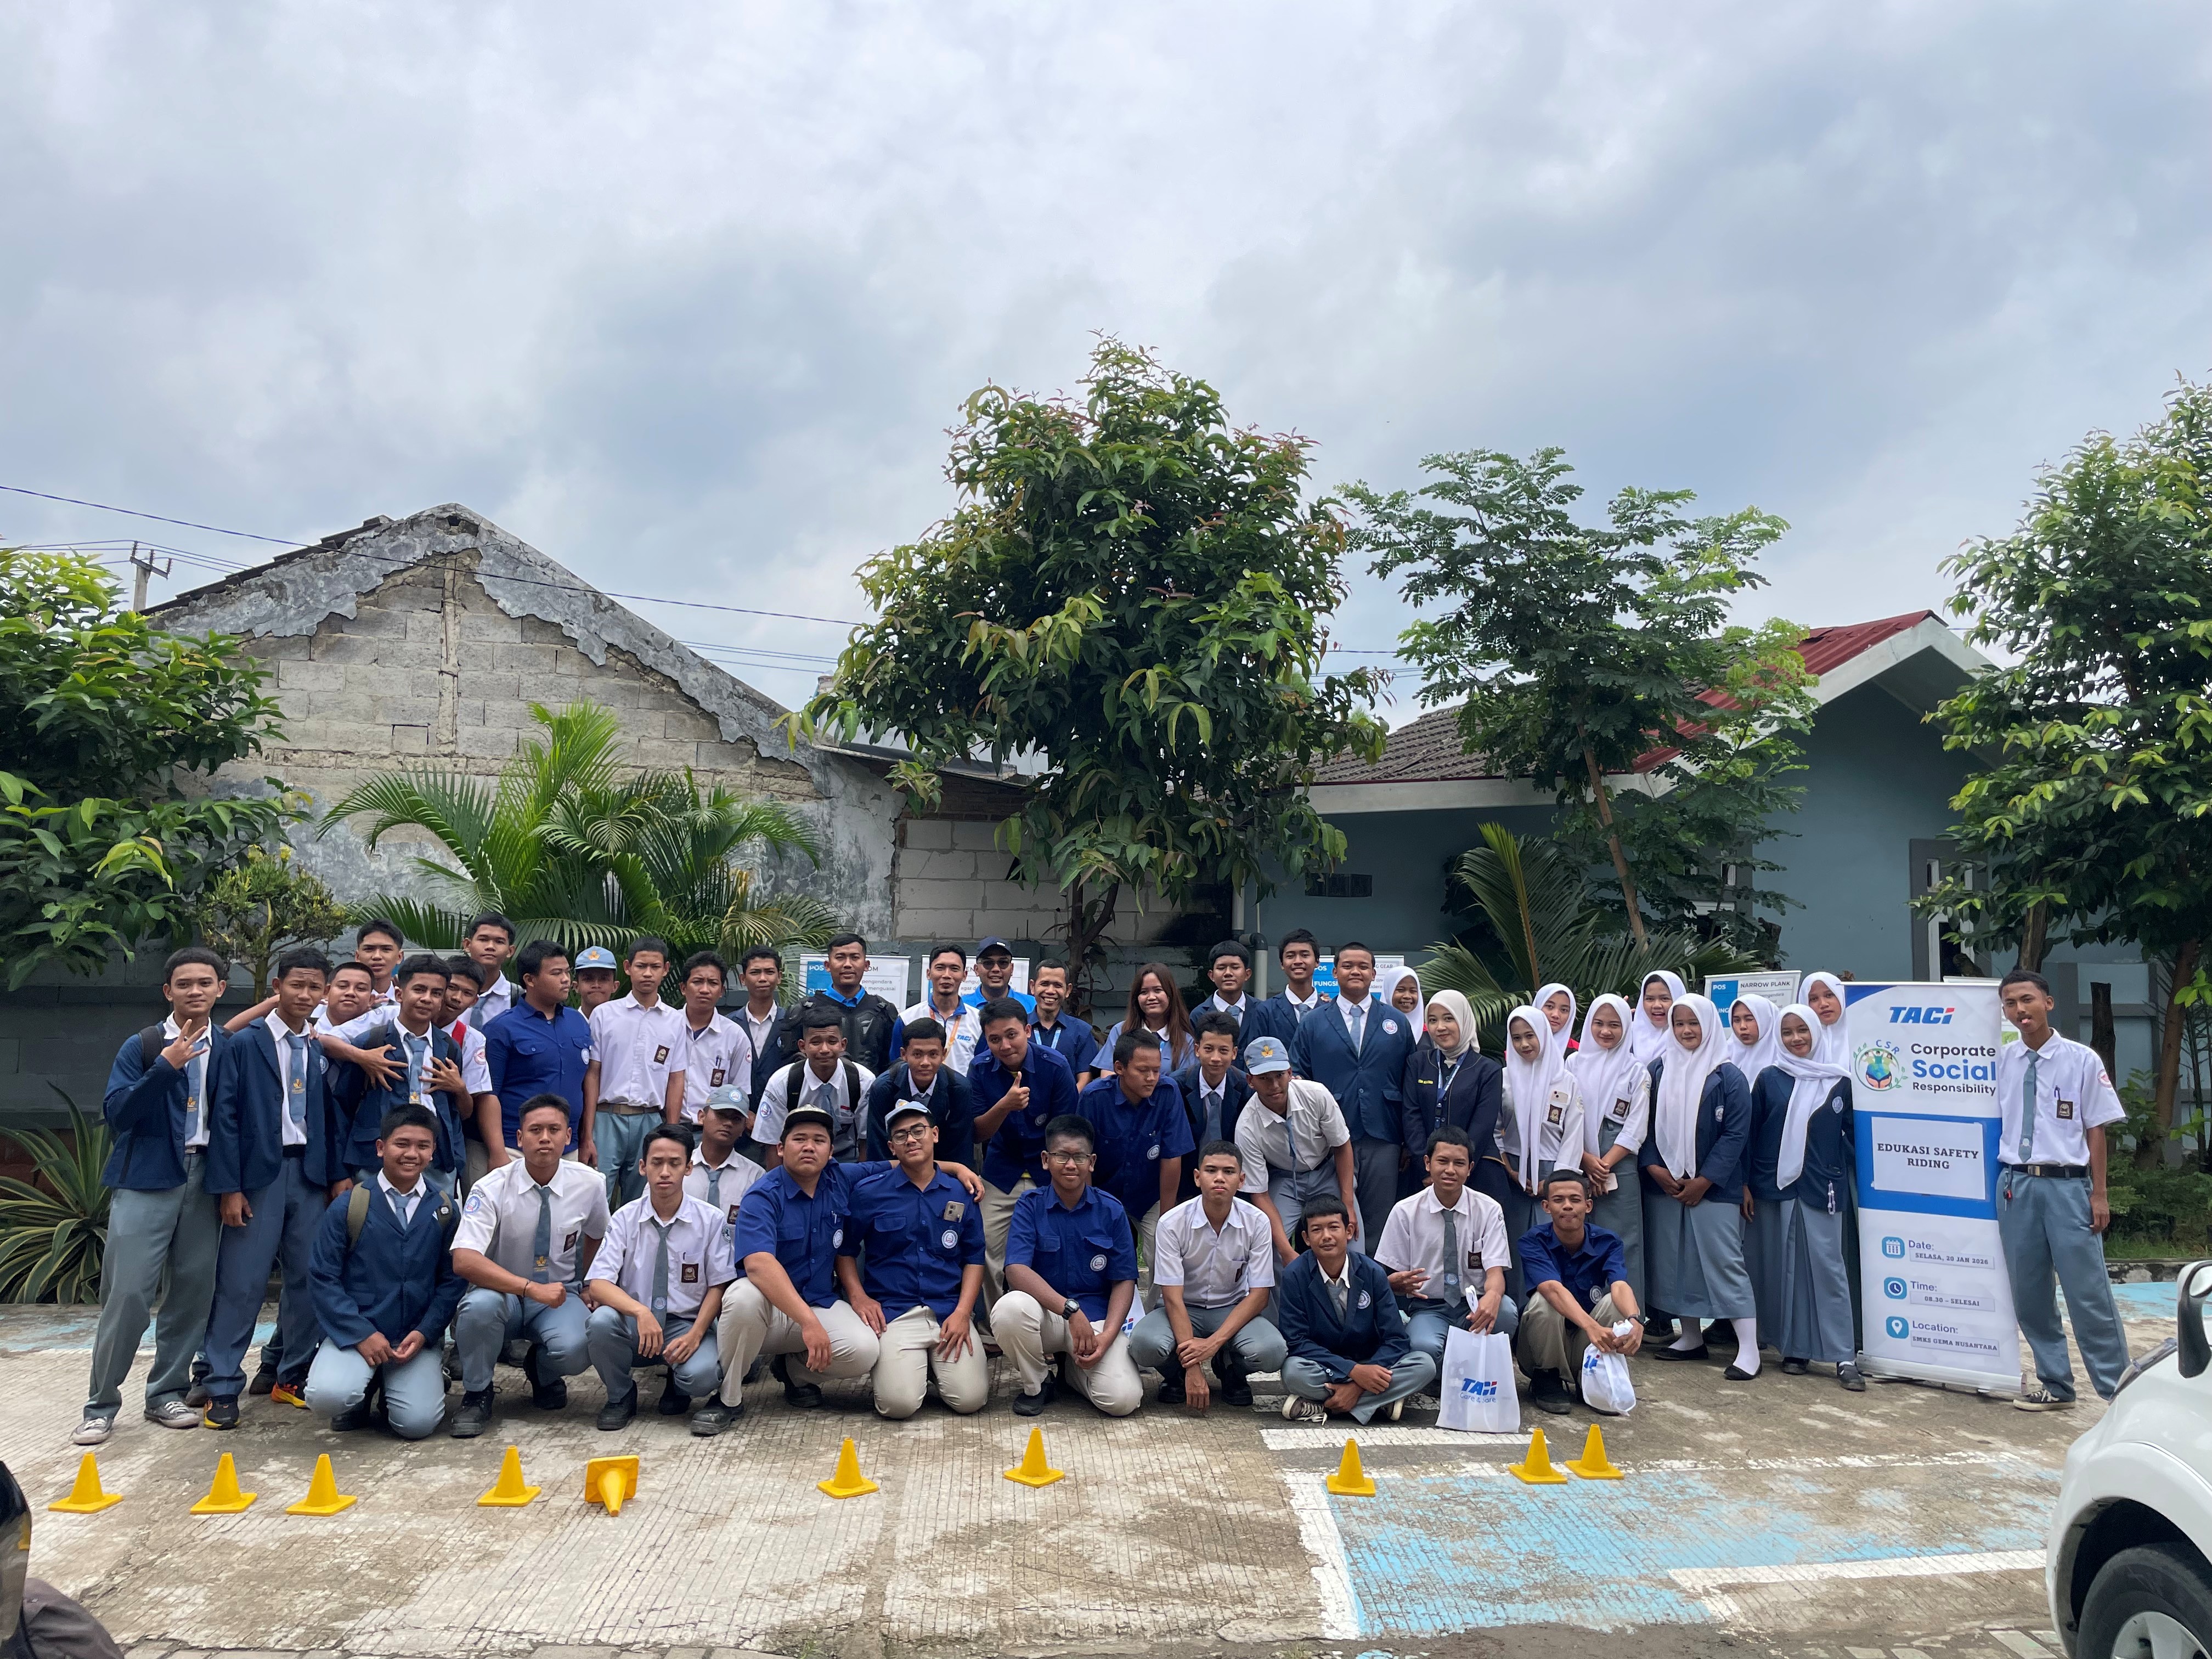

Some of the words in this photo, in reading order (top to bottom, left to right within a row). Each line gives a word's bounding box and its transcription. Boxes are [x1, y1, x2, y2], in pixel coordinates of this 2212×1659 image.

[1911, 1043, 1996, 1059] Corporate
[1912, 1059, 1996, 1081] Social
[1912, 1082, 1996, 1096] Responsibility
[1877, 1143, 1929, 1155] EDUKASI
[1934, 1147, 1979, 1159] SAFETY
[1907, 1158, 1950, 1169] RIDING
[1909, 1240, 1934, 1250] Date:
[1915, 1252, 1944, 1261] SELASA,
[1910, 1280, 1937, 1291] Time:
[1950, 1298, 1980, 1306] SELESAI
[1912, 1321, 1959, 1334] Location:
[1955, 1341, 1997, 1351] NUSANTARA
[1460, 1392, 1475, 1402] Care
